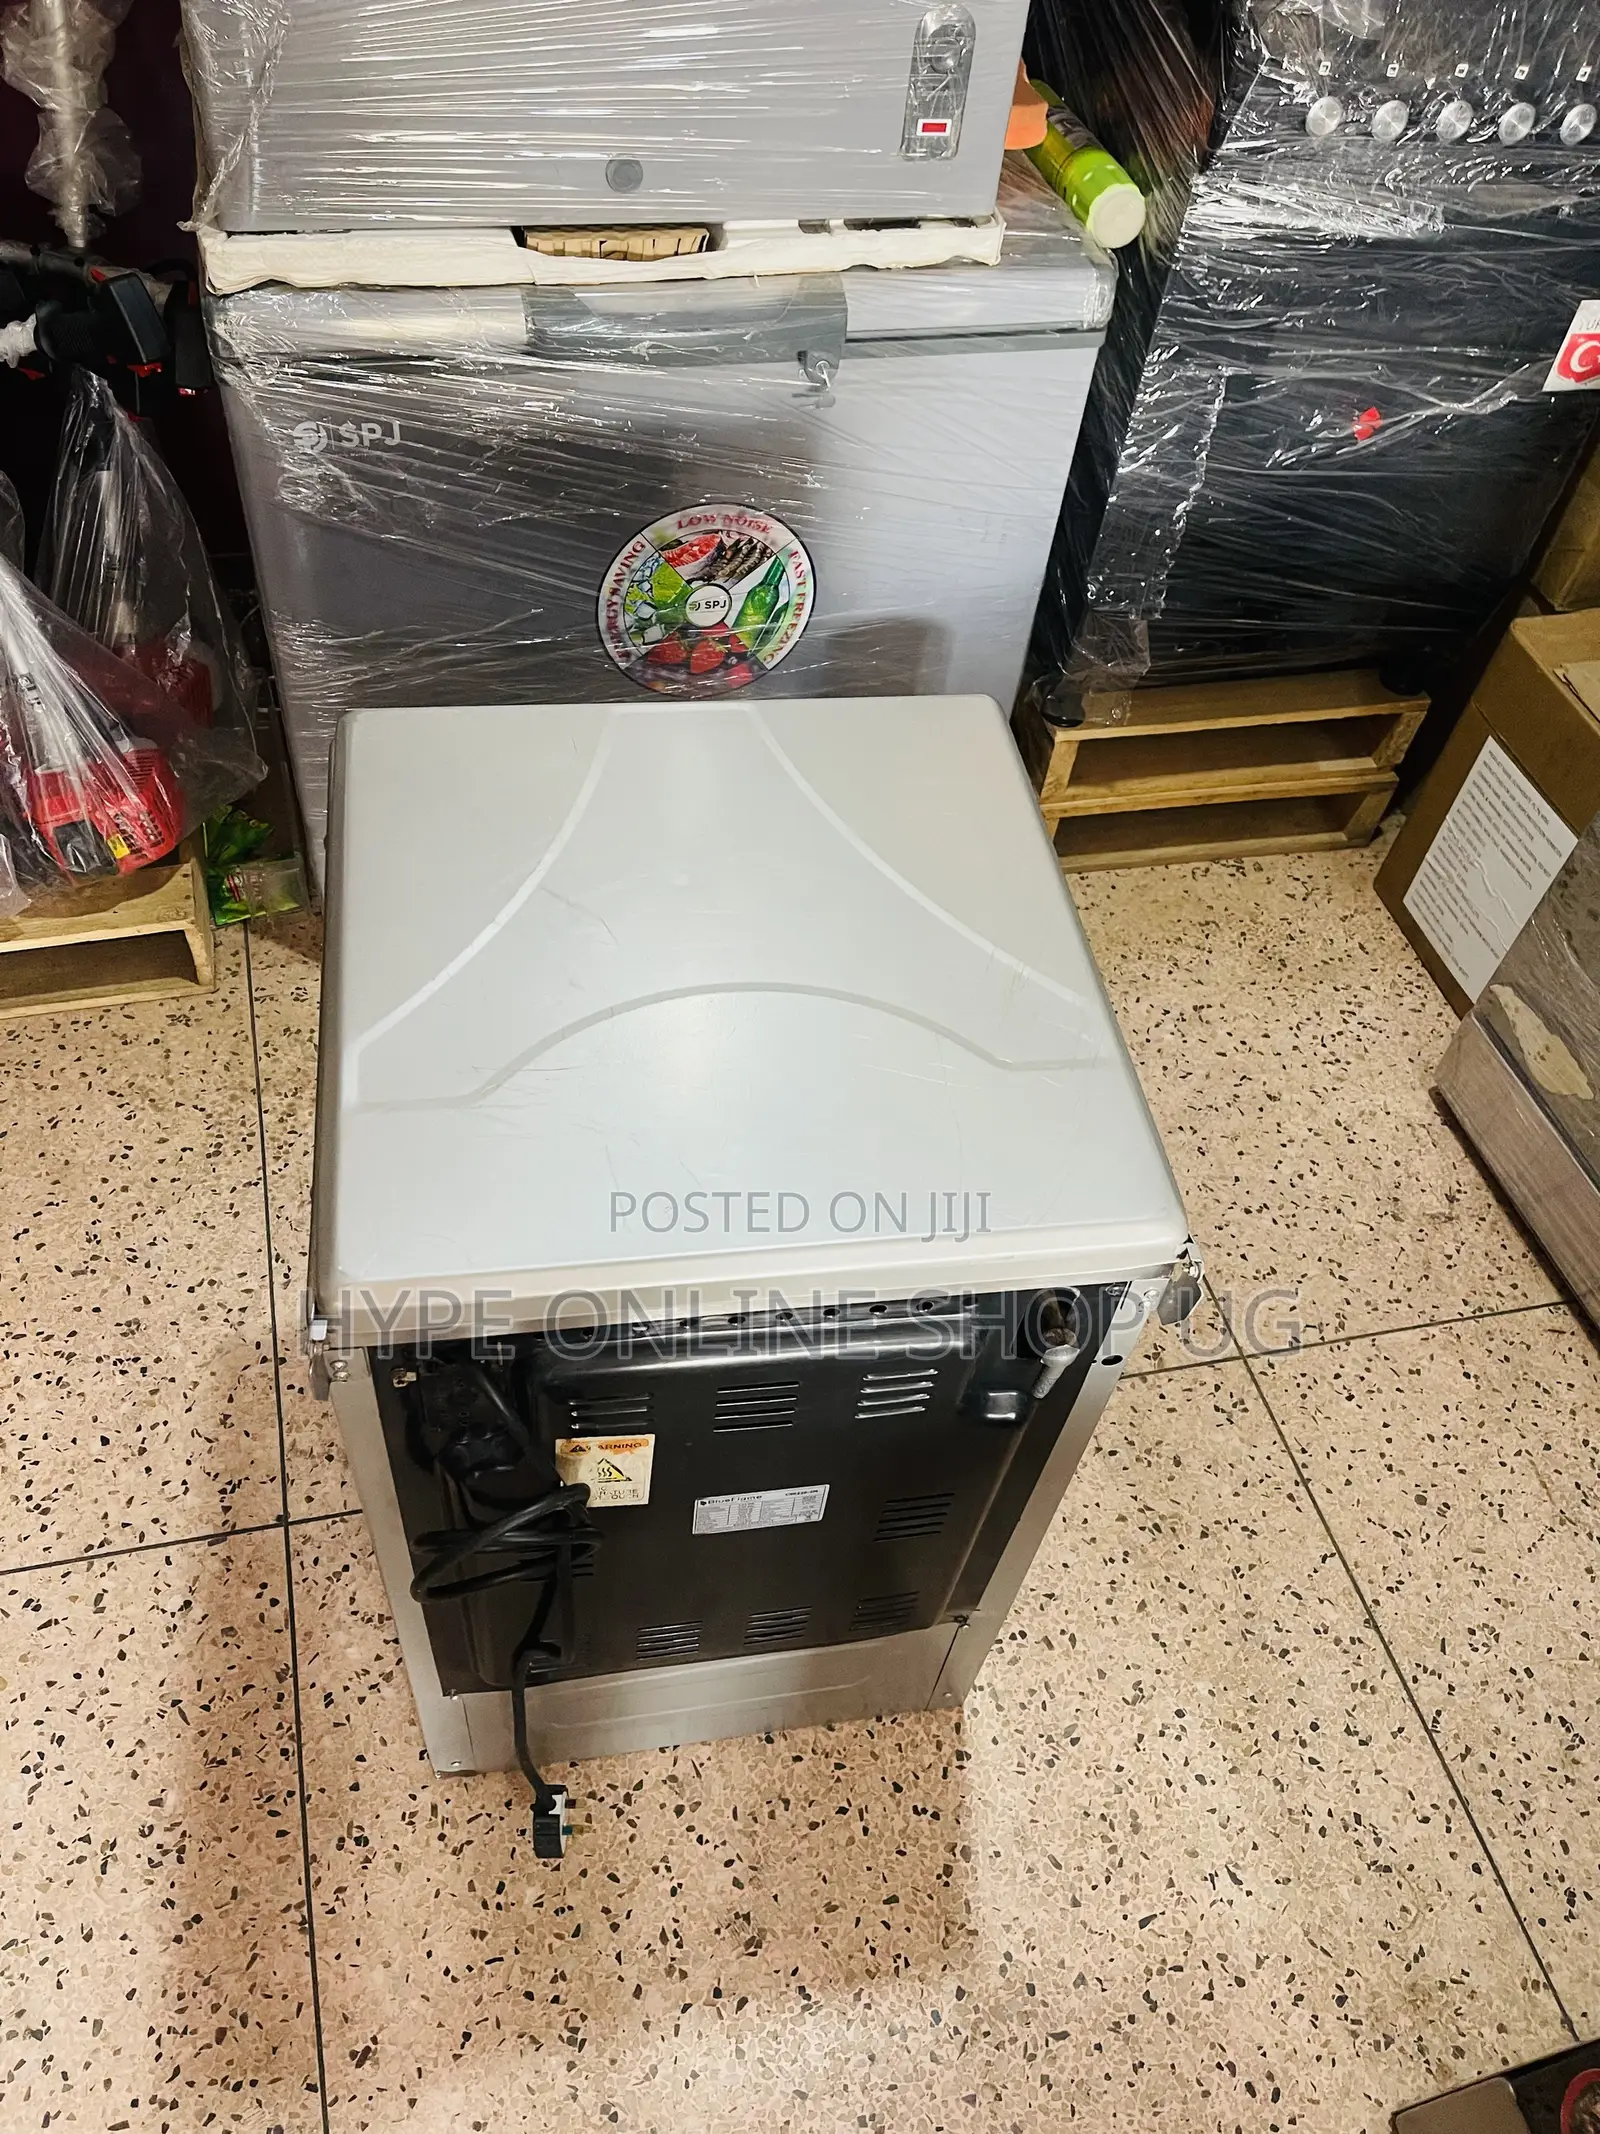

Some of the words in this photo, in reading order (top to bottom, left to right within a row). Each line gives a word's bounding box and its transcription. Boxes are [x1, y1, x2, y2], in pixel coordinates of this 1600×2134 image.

[338, 421, 400, 447] SPJ
[677, 514, 717, 529] LOW
[722, 514, 772, 534] NOISE
[788, 550, 807, 590] FAST
[704, 600, 727, 609] SPJ
